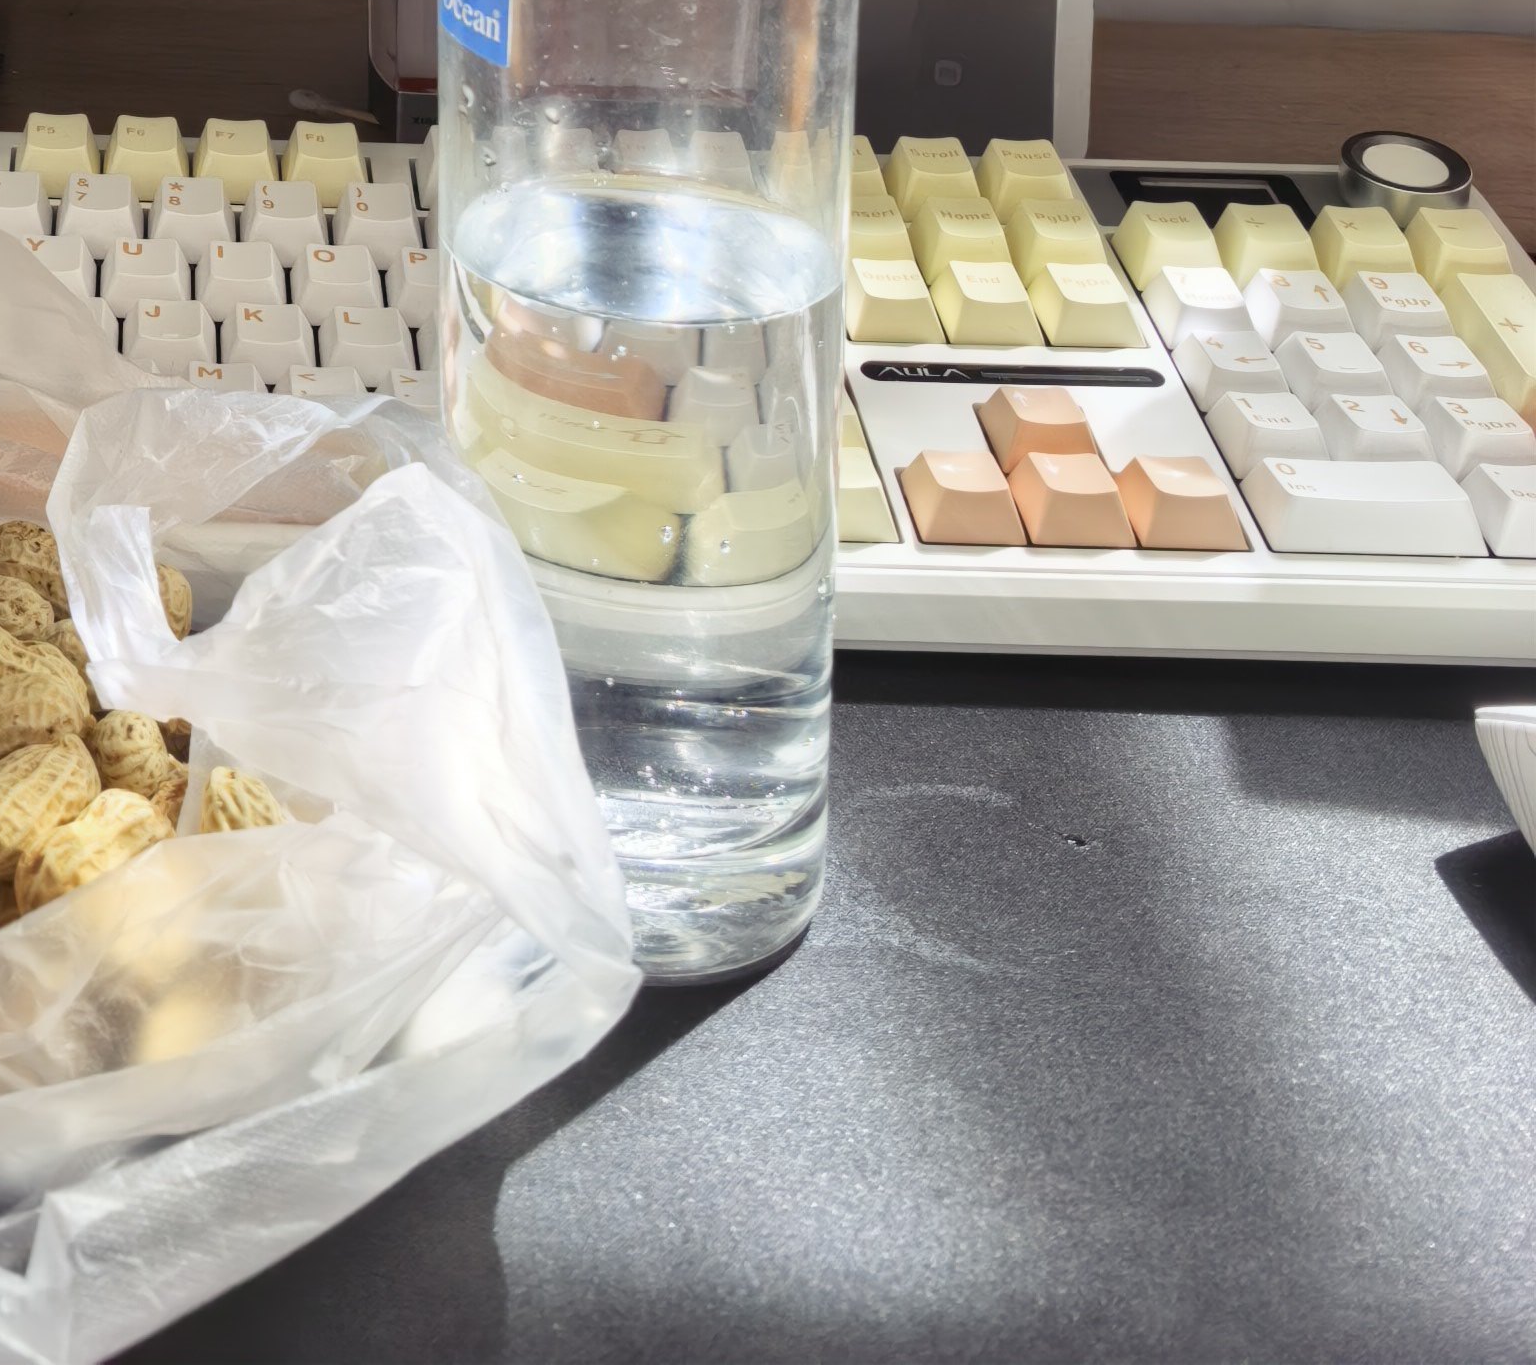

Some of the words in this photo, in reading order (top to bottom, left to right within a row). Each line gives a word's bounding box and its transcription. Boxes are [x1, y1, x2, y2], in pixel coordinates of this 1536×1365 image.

[36, 125, 56, 135] F5
[125, 126, 146, 138] F6
[214, 130, 236, 141] F7
[304, 133, 325, 144] F8
[909, 148, 960, 159] Scroll
[1001, 149, 1052, 161] Pause
[76, 191, 88, 201] 7
[168, 196, 181, 206] 8
[262, 199, 275, 210] 9
[940, 209, 991, 220] Home
[1034, 212, 1082, 224] PgUp
[1145, 213, 1191, 224] Lock
[26, 238, 44, 252] Y
[122, 242, 143, 256] U
[216, 245, 224, 259] I
[409, 252, 428, 265] P
[862, 272, 921, 283] Delete
[966, 274, 1001, 285] End
[1368, 276, 1389, 290] 9
[1381, 295, 1433, 309] PgUp
[144, 305, 162, 319] J
[243, 308, 263, 322] K
[344, 311, 362, 325] L
[1305, 337, 1325, 351] 5
[1407, 340, 1429, 355] 6
[197, 367, 223, 380] M
[877, 366, 971, 380] AULA
[1233, 397, 1252, 409] 1
[1341, 398, 1365, 413] 2
[1446, 401, 1469, 415] 3
